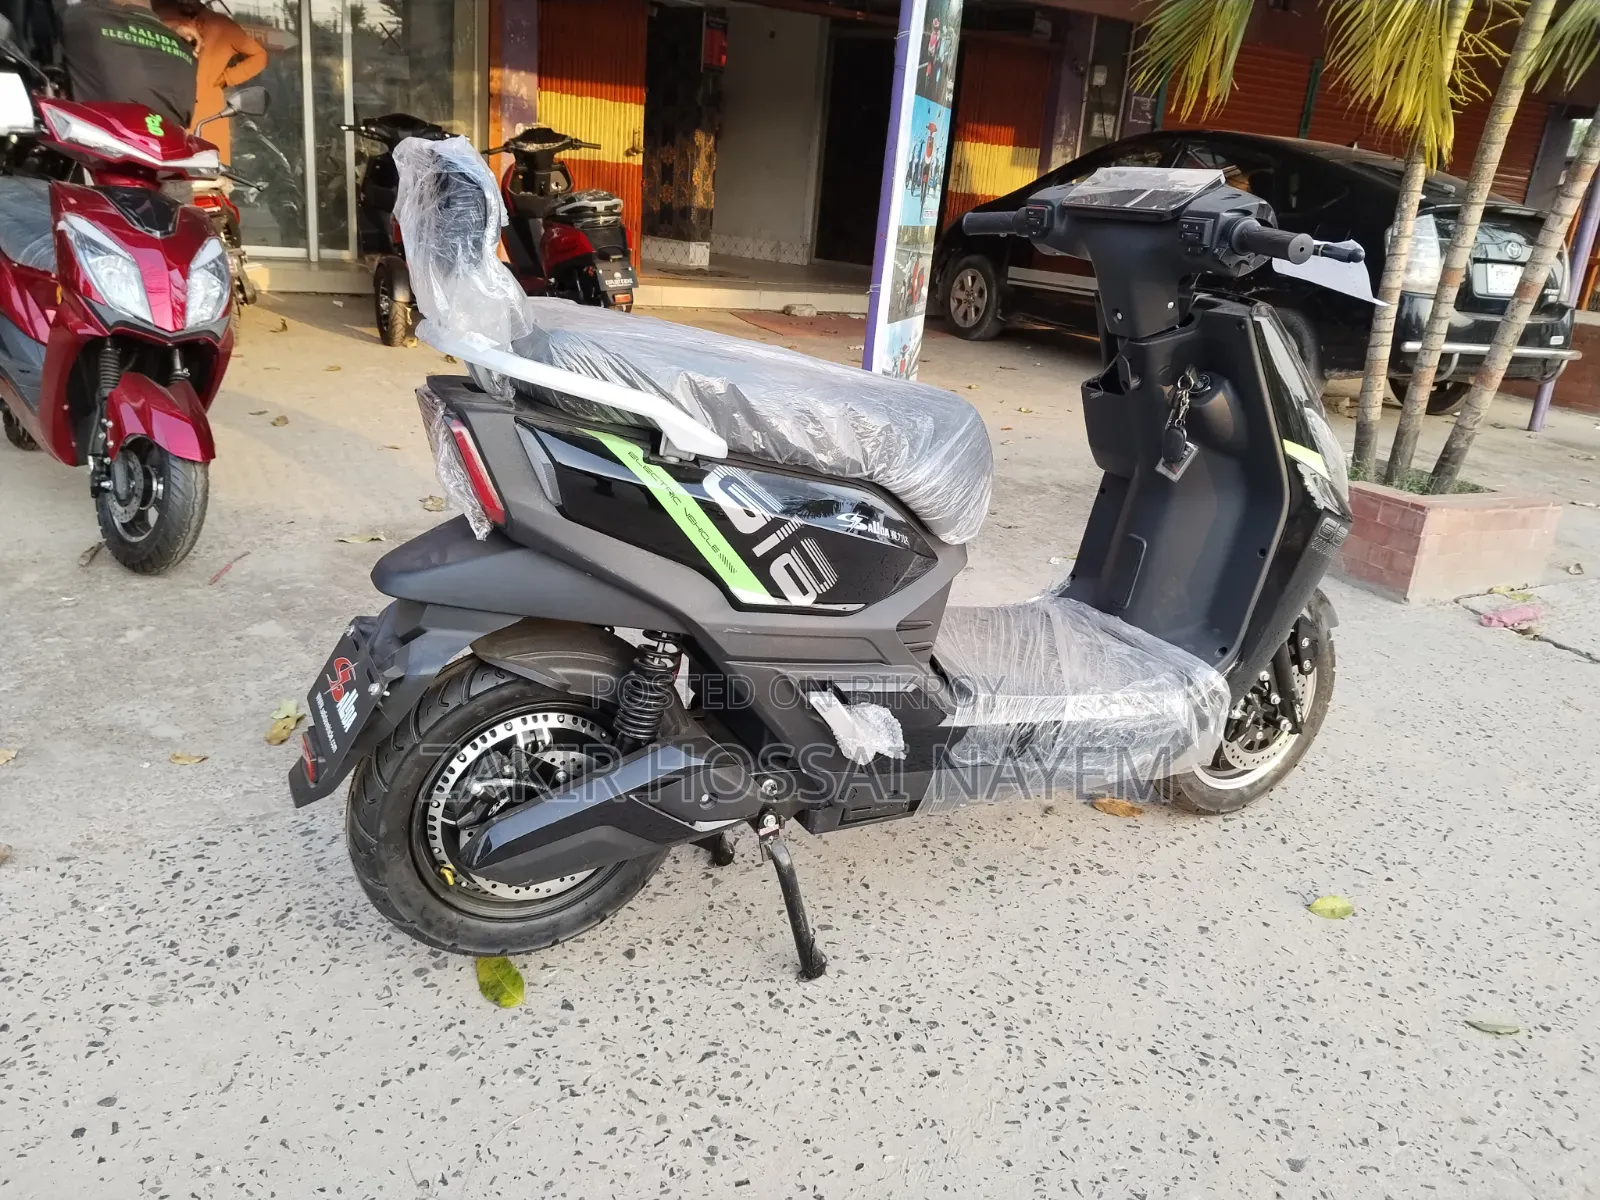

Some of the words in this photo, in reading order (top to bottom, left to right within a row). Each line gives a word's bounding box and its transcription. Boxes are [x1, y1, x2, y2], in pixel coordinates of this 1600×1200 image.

[101, 28, 157, 48] ELECTRIC
[128, 25, 179, 49] SALIDA
[627, 451, 682, 506] ELECTRIC
[684, 507, 721, 554] VEHICLE
